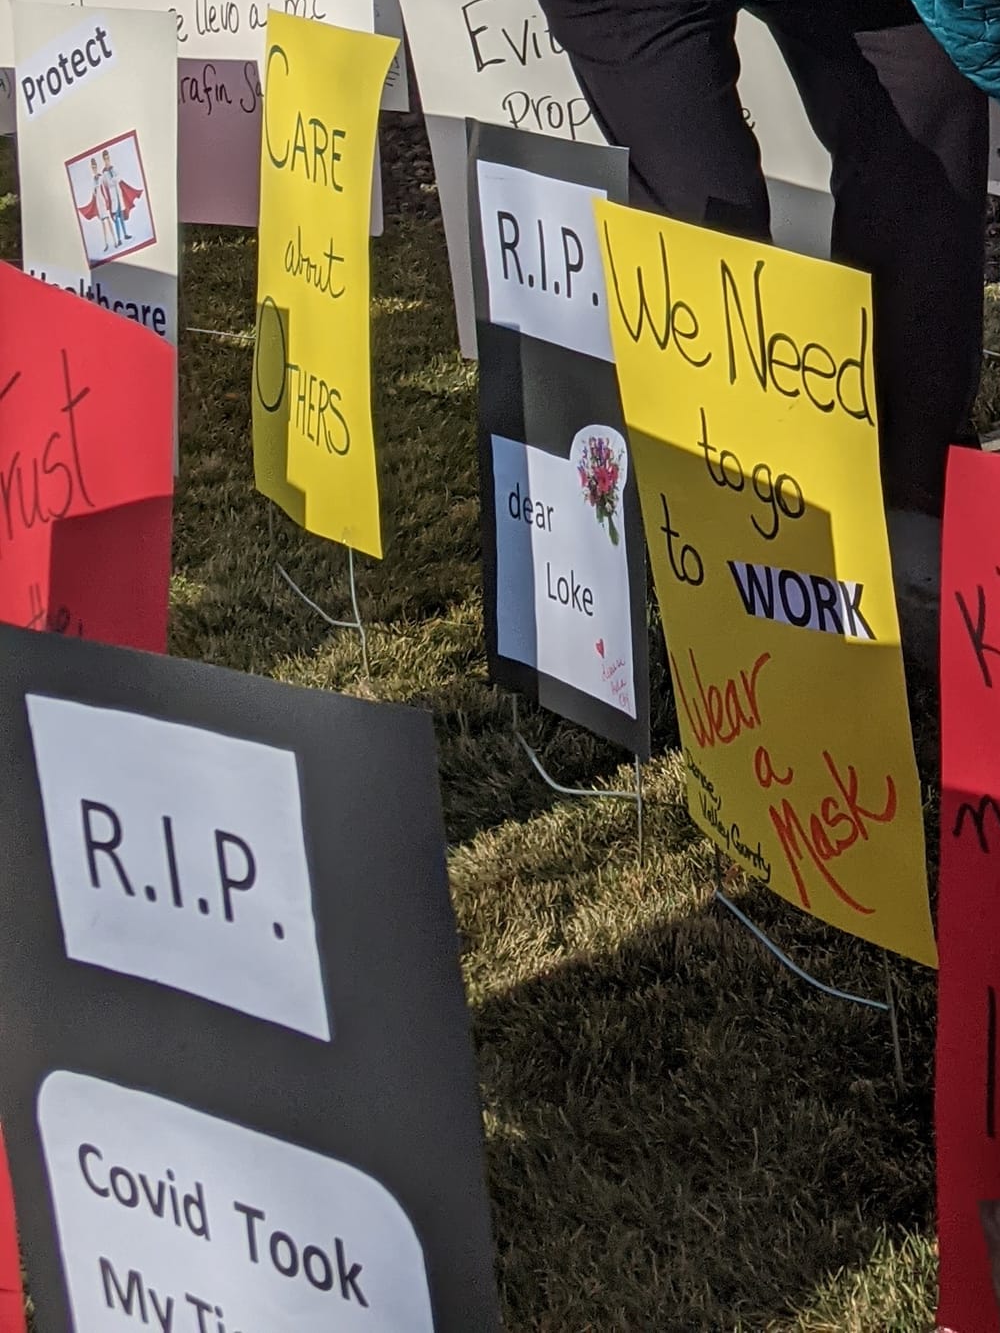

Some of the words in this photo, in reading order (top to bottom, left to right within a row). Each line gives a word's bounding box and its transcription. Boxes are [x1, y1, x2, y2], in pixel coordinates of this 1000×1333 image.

[249, 5, 267, 31] a
[21, 26, 113, 115] Protect
[264, 44, 347, 193] CARE
[501, 90, 593, 141] Prop
[284, 226, 346, 299] about
[496, 210, 599, 308] R.I.P.
[602, 220, 712, 368] We
[720, 259, 876, 427] Need
[255, 295, 351, 456] OTHERS
[0, 348, 95, 540] rust
[507, 482, 554, 533] dear
[545, 561, 594, 618] Loke
[660, 492, 705, 587] to
[727, 560, 877, 641] WORK
[671, 648, 772, 749] Wear
[754, 745, 794, 788] a
[80, 797, 285, 941] R.I.P.
[768, 750, 897, 915] Mask
[77, 1142, 211, 1242] Covid
[233, 1200, 370, 1308] Took
[98, 1255, 175, 1333] My
